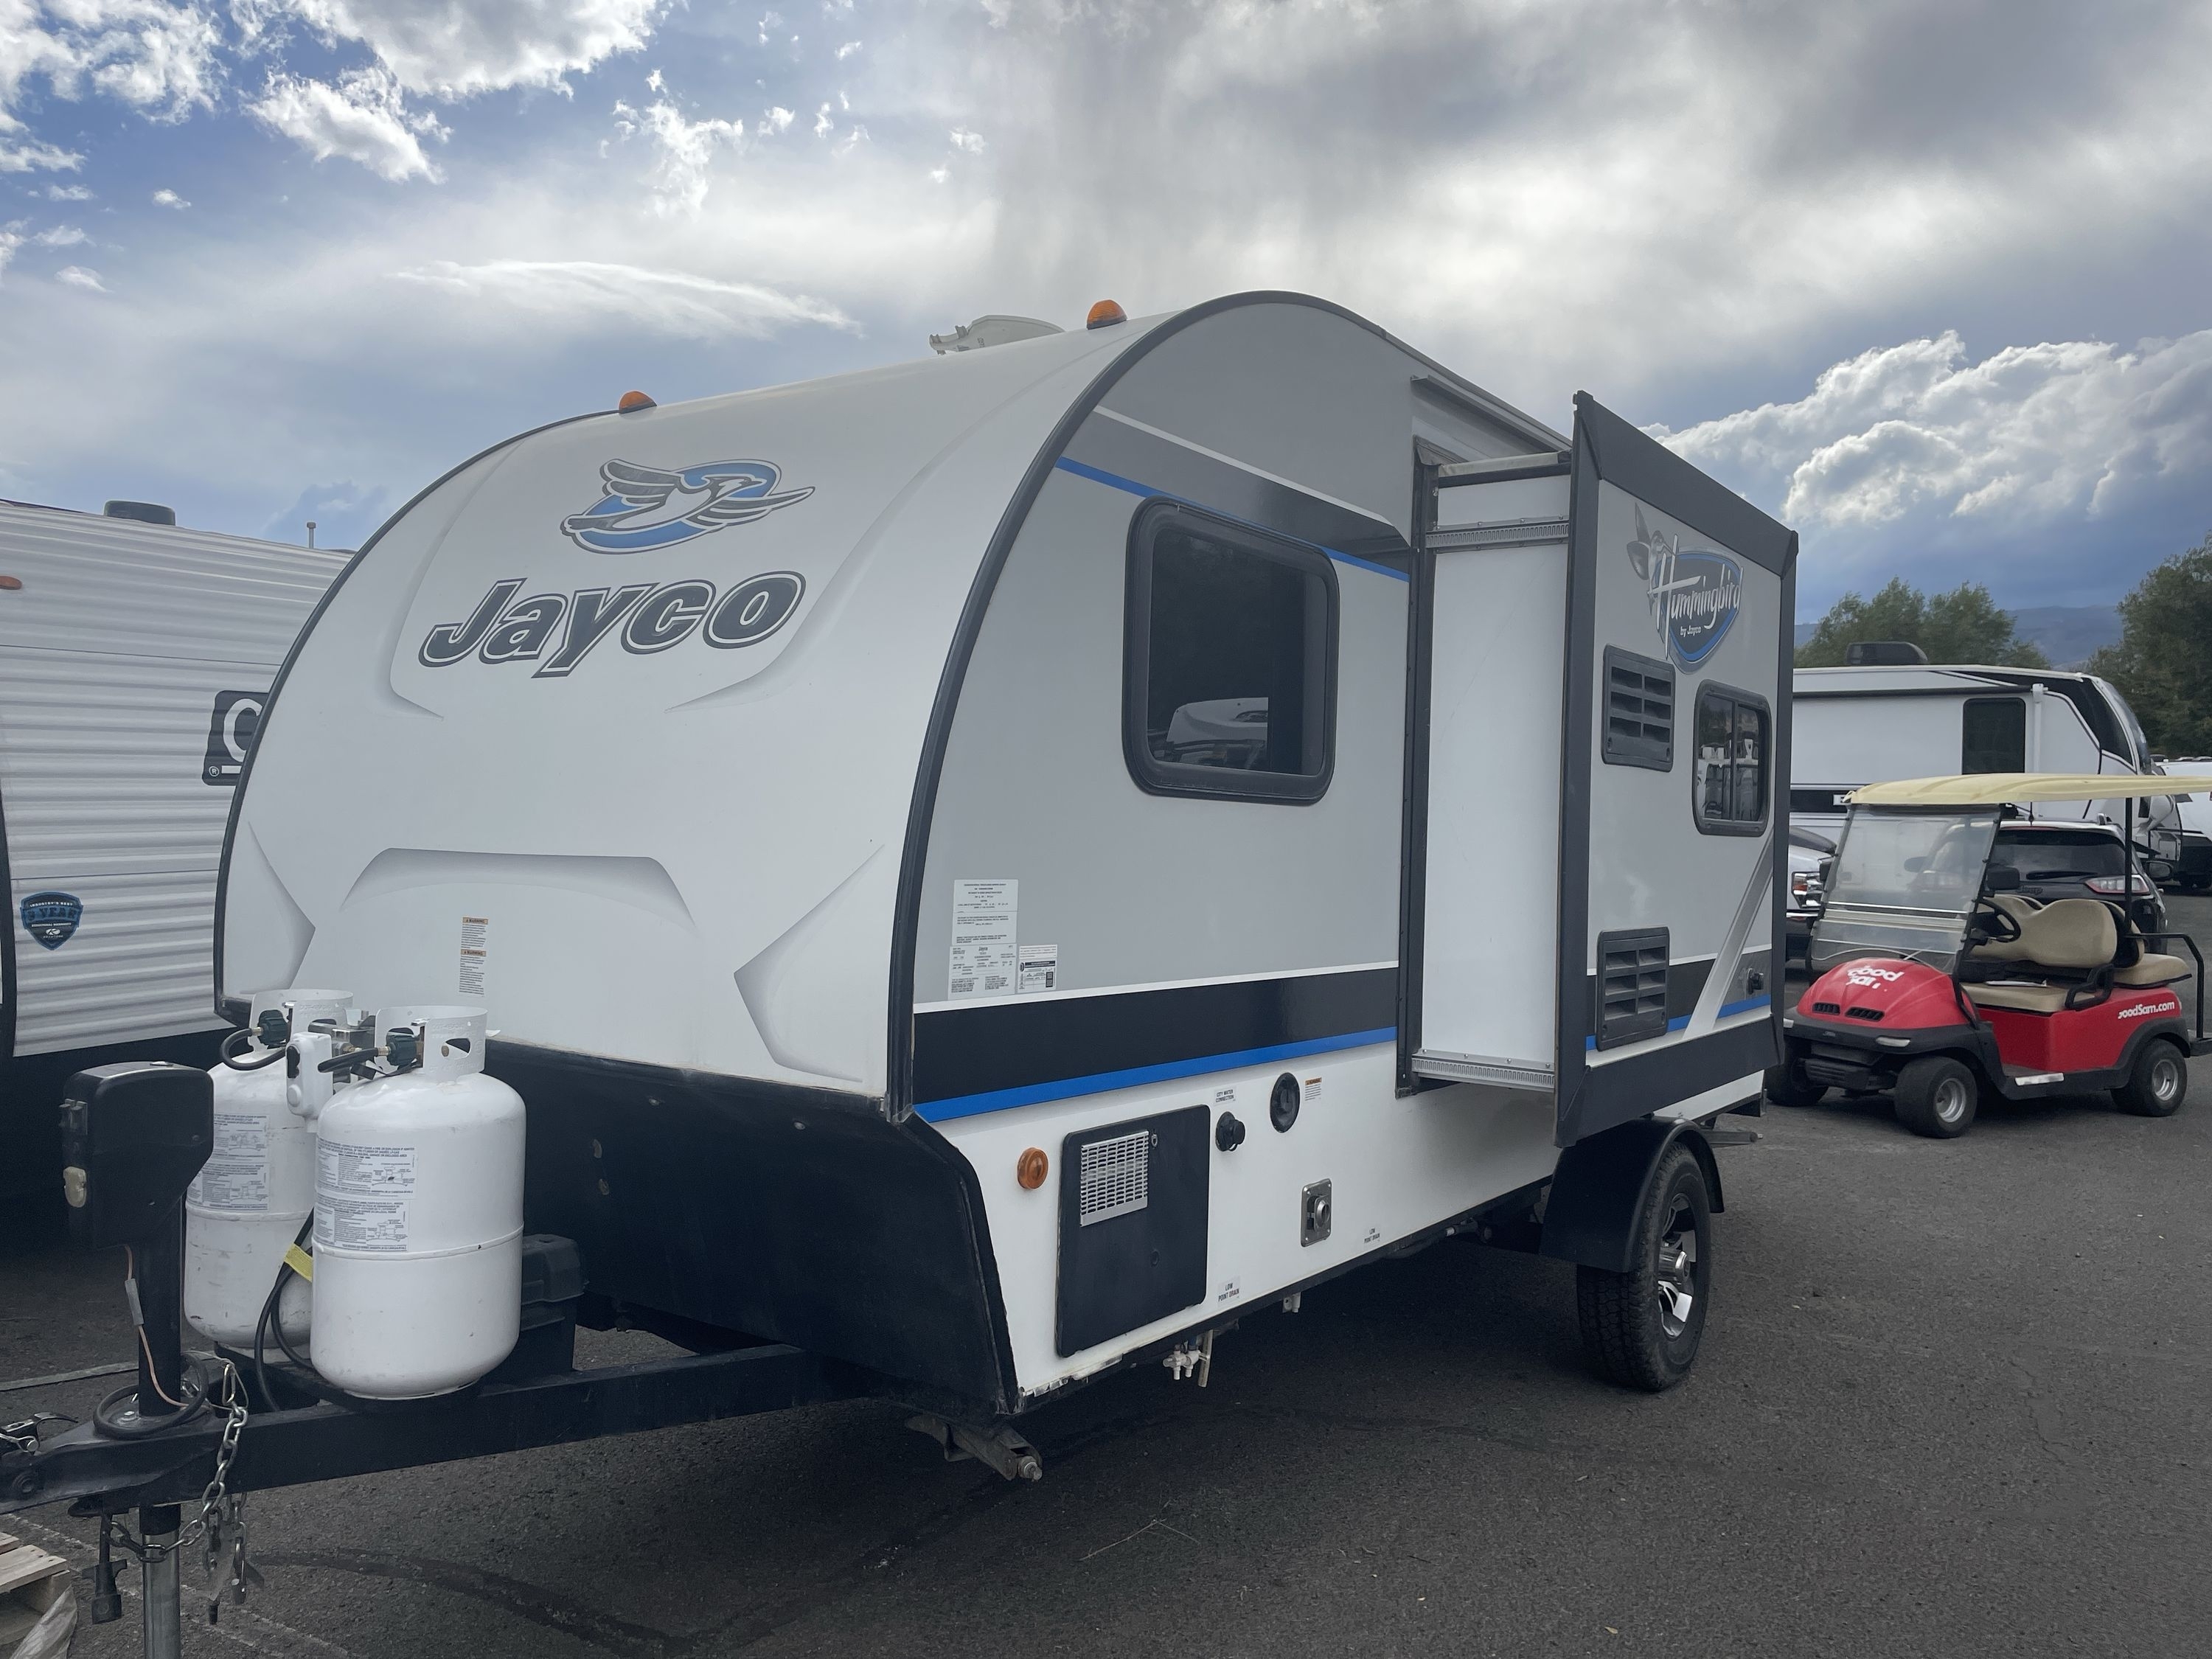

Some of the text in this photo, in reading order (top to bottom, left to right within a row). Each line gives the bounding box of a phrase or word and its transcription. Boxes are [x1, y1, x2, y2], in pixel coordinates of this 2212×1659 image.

[418, 577, 806, 678] Jayco
[1647, 534, 1744, 661] Hummingbird
[1687, 625, 1702, 636] Jayco
